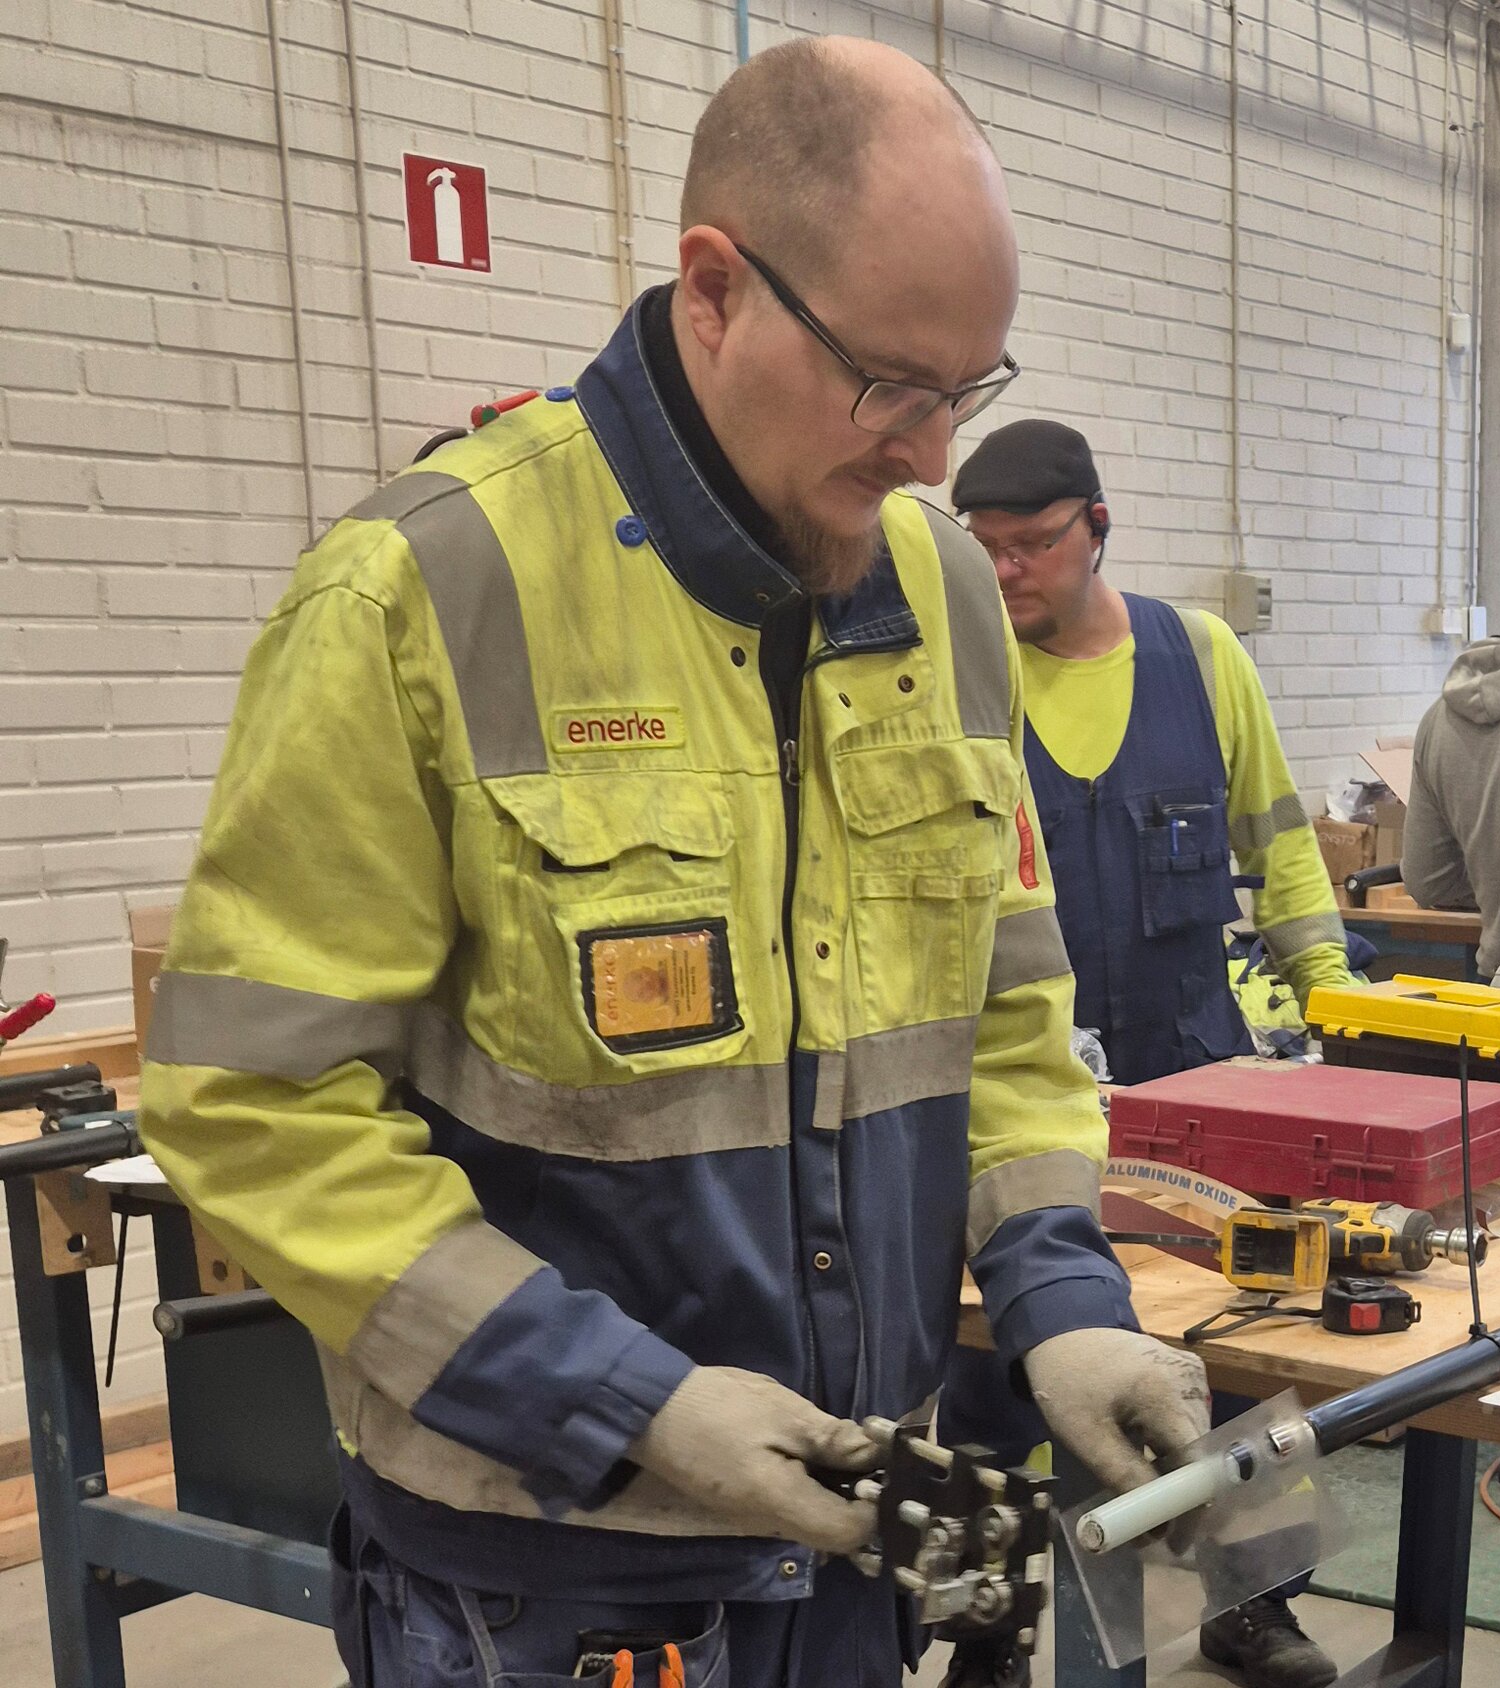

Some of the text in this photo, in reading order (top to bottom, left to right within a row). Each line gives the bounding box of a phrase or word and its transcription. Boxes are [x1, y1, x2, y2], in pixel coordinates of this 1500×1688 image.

[568, 711, 666, 743] enerke
[1106, 1163, 1238, 1210] ALUMINUM OXIDE
